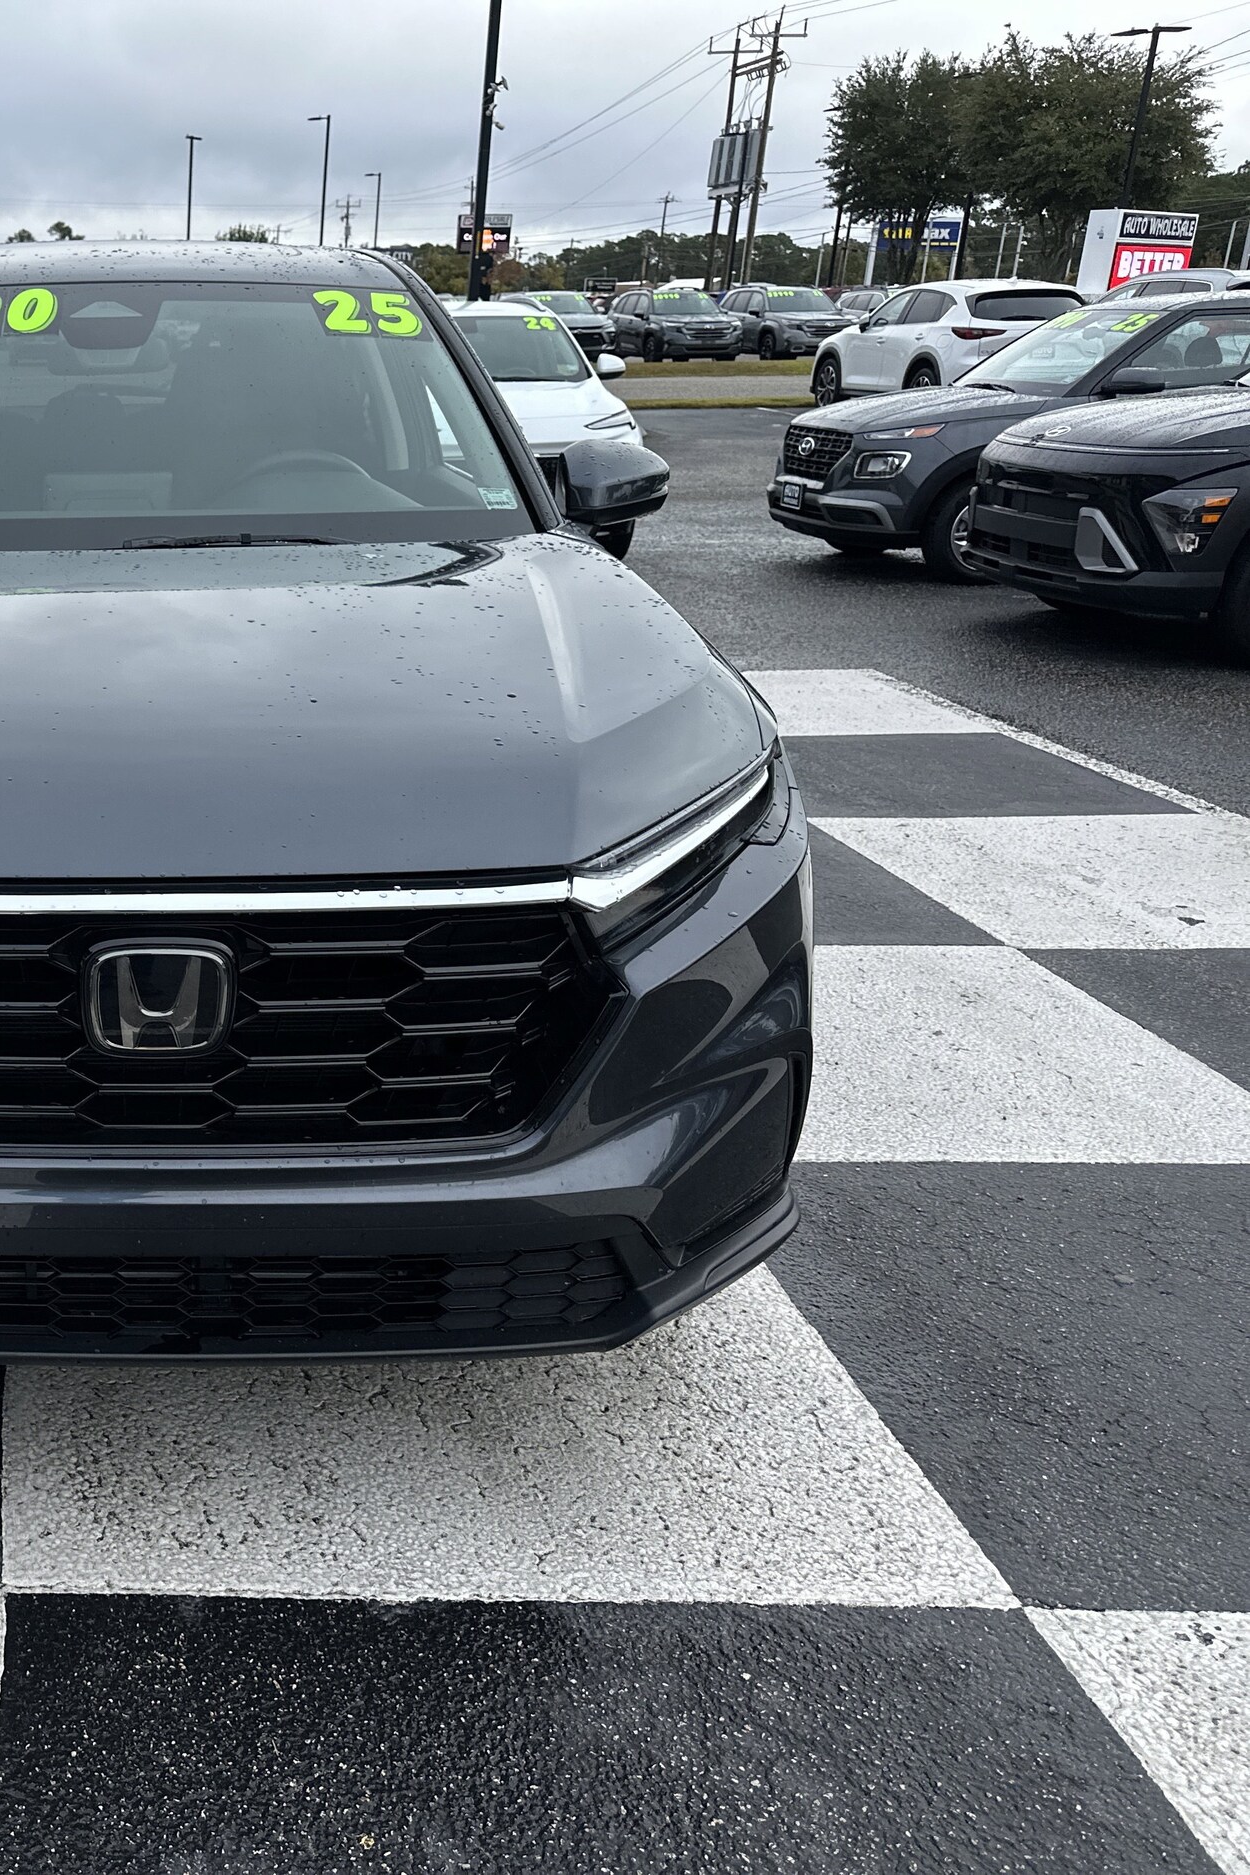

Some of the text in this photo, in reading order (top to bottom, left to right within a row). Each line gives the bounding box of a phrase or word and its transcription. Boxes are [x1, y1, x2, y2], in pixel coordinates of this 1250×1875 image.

[1123, 216, 1196, 238] AUTO WHOLESALE
[1117, 250, 1185, 279] BETTER
[312, 290, 422, 337] 25
[1110, 313, 1160, 332] 25
